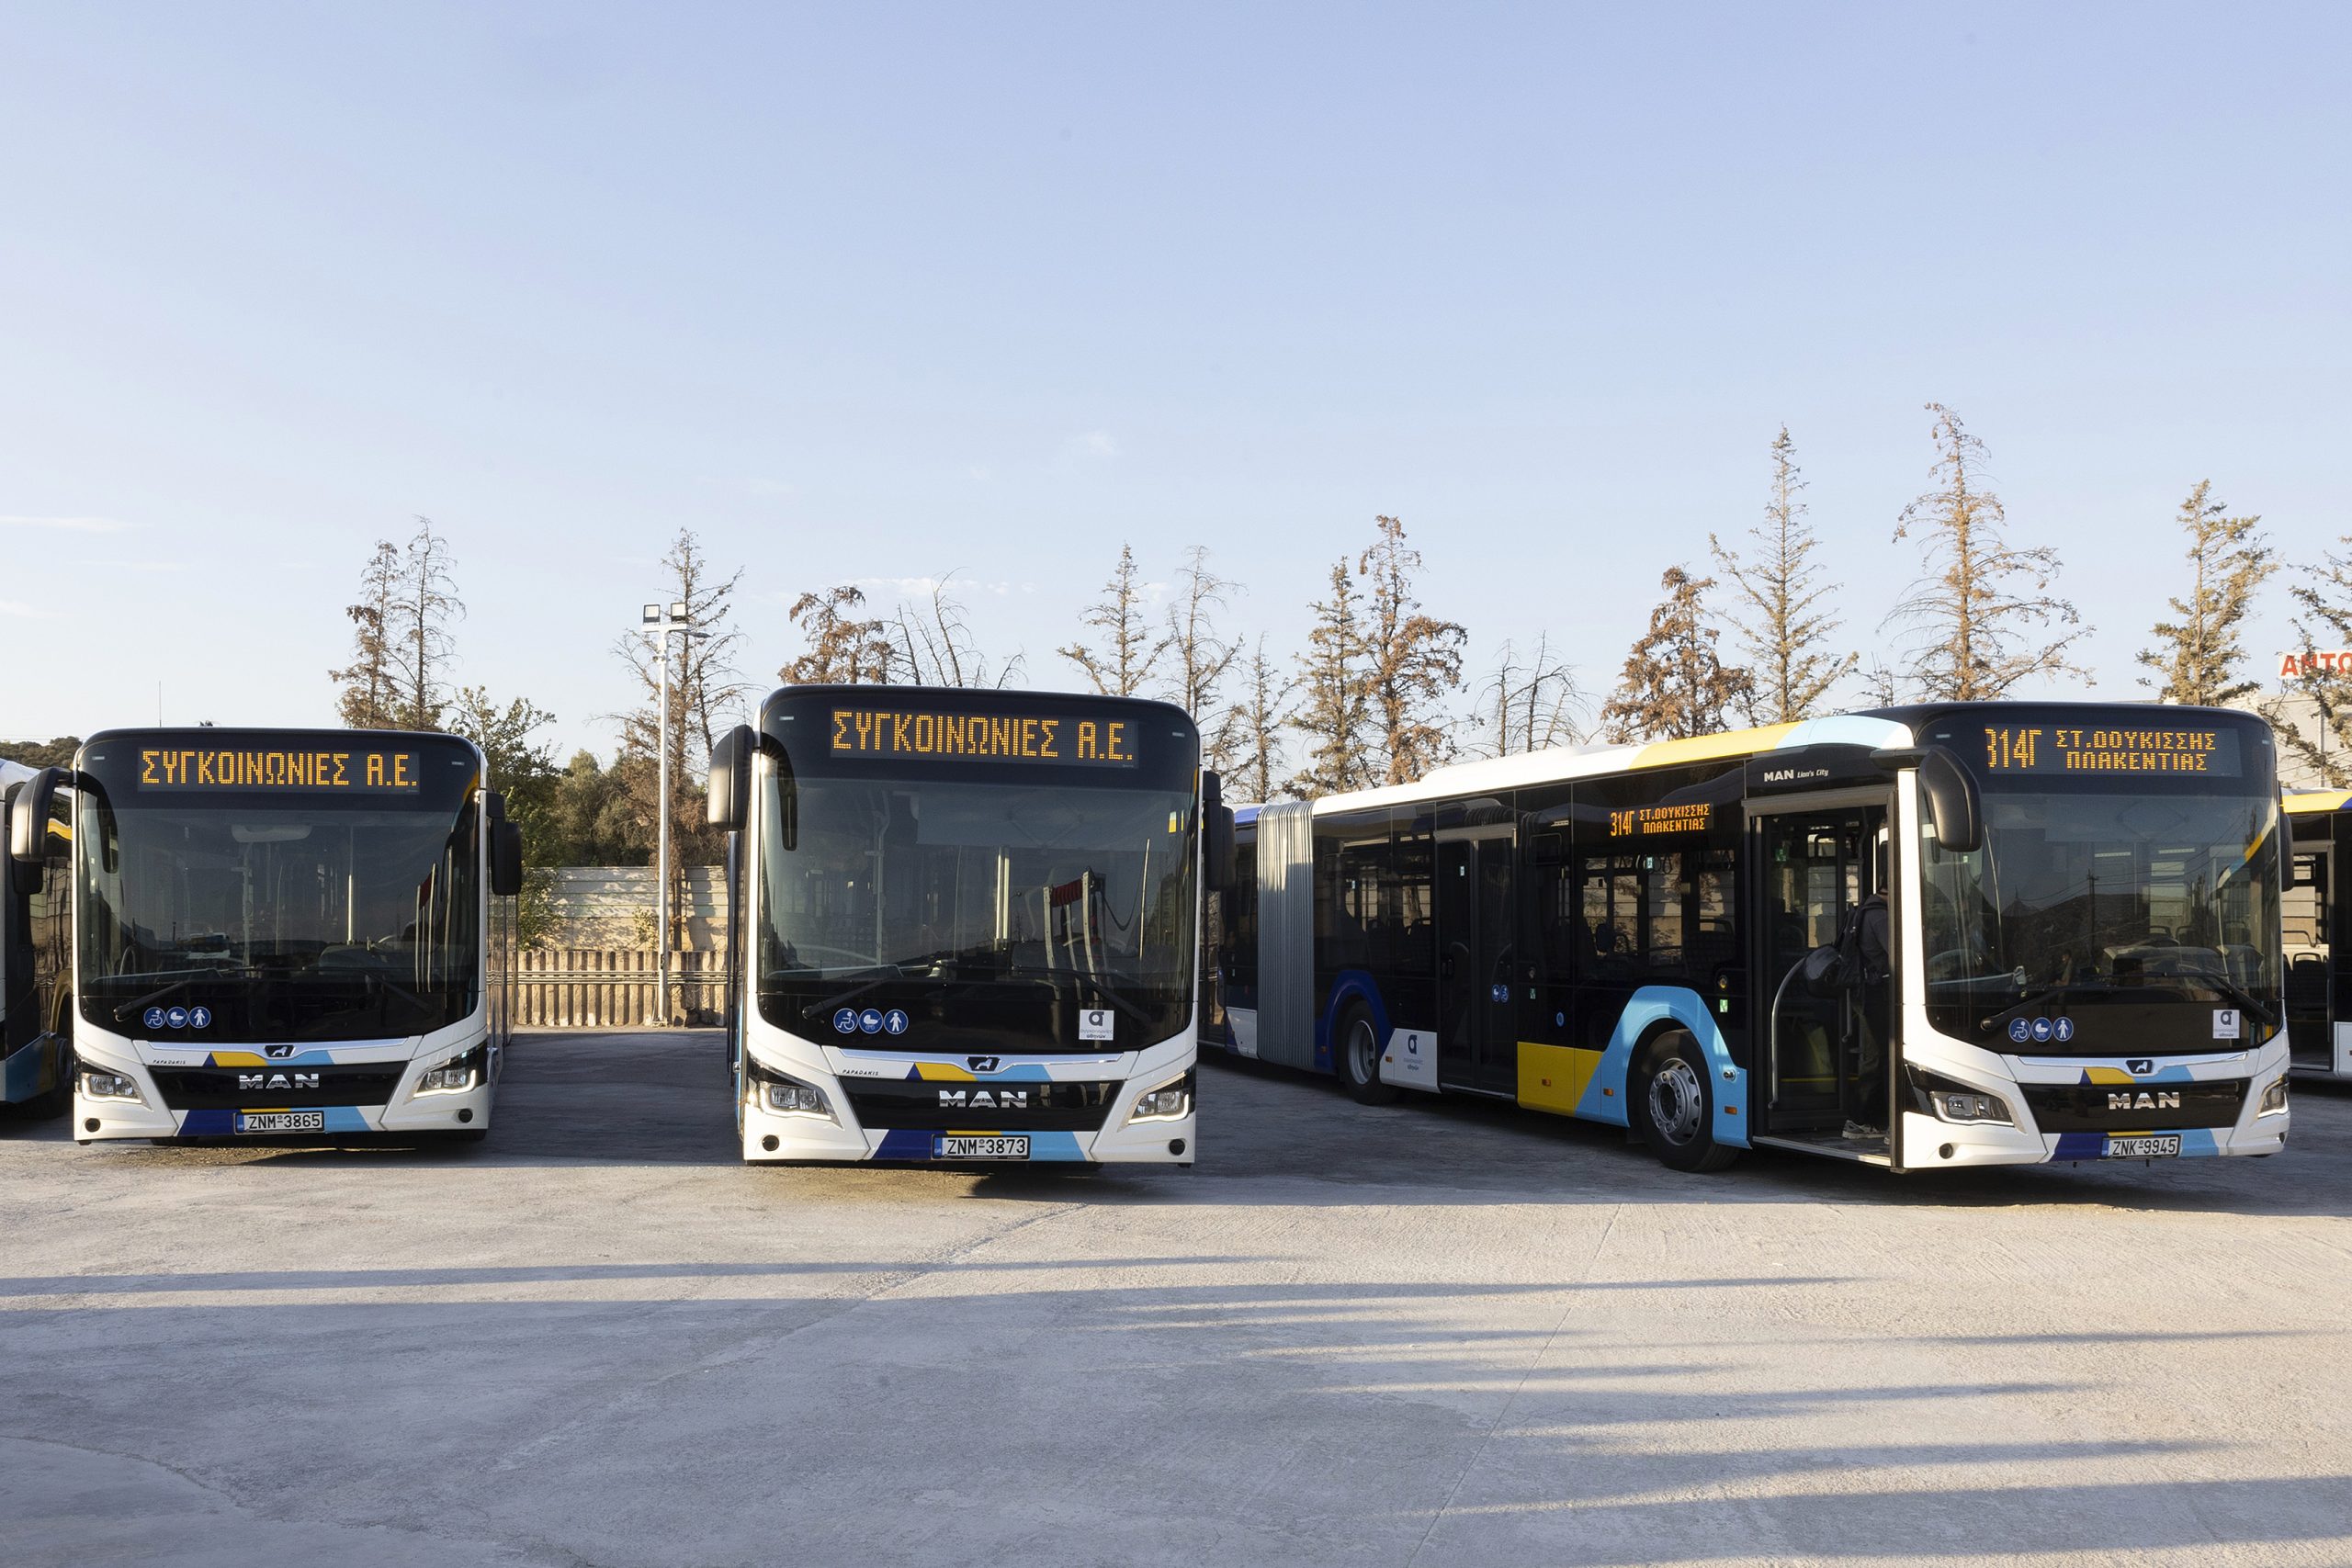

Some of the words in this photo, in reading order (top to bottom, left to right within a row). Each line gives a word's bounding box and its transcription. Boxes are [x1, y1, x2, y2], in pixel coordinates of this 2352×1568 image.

[833, 711, 1059, 758] ΣΥΓΚΟΙΝΩΝΙΕΣ
[1078, 721, 1133, 761] Α.Ε.
[142, 750, 349, 785] ΣΥΓΚΟΙΝΩΝΙΕΣ
[367, 753, 417, 786] Α.Ε.
[2066, 751, 2207, 771] ΠΛΑΚΕΝΤΙΑΣ
[1763, 769, 1794, 782] MAN
[1815, 769, 1829, 777] City
[1610, 810, 1635, 837] 314Γ
[1643, 818, 1706, 834] ΠΛΑΚΕΝΤΙΑΣ
[238, 1073, 320, 1090] MAN
[842, 1068, 879, 1077] PAPADAKIS
[938, 1089, 1027, 1109] MAN
[2108, 1091, 2180, 1110] MAN
